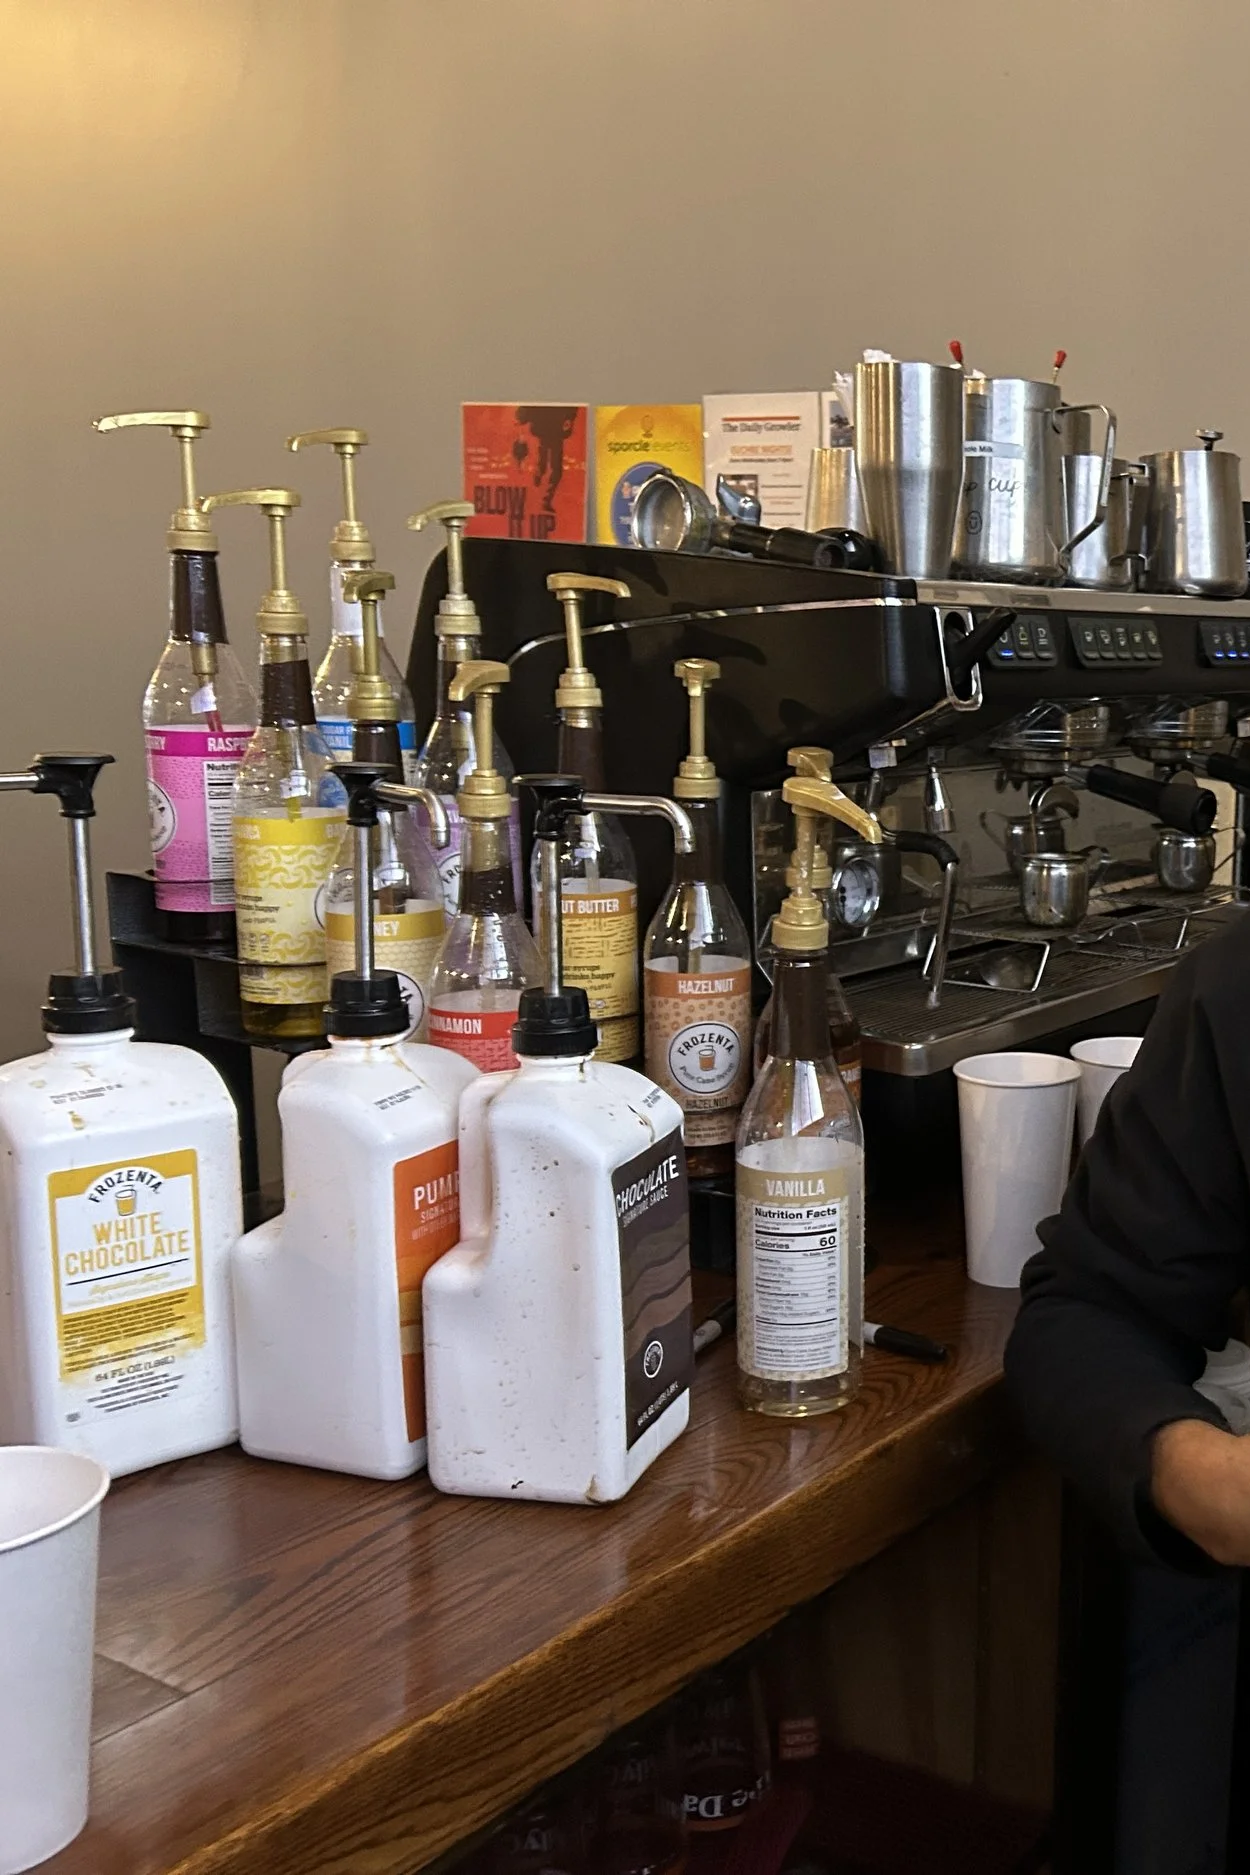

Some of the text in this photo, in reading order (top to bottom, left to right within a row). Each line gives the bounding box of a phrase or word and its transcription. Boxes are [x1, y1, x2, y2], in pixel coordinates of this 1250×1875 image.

[722, 422, 801, 434] The Daily Growler
[474, 486, 526, 520] BLOW
[577, 898, 619, 914] BUTTER
[678, 978, 735, 994] HAZELNUT
[677, 1032, 735, 1056] FROZENTA
[686, 1097, 729, 1109] HAZELNUT
[88, 1169, 163, 1203] FROZENTA
[616, 1155, 679, 1217] CHOCOLATE
[649, 1185, 669, 1206] SAUCE
[766, 1178, 825, 1197] VANILLA
[755, 1207, 837, 1219] Nutrition Facts
[93, 1211, 163, 1245] WHITE
[65, 1230, 190, 1276] CHOCOLATE
[755, 1235, 836, 1250] Calories 60
[682, 1793, 724, 1818] Da
